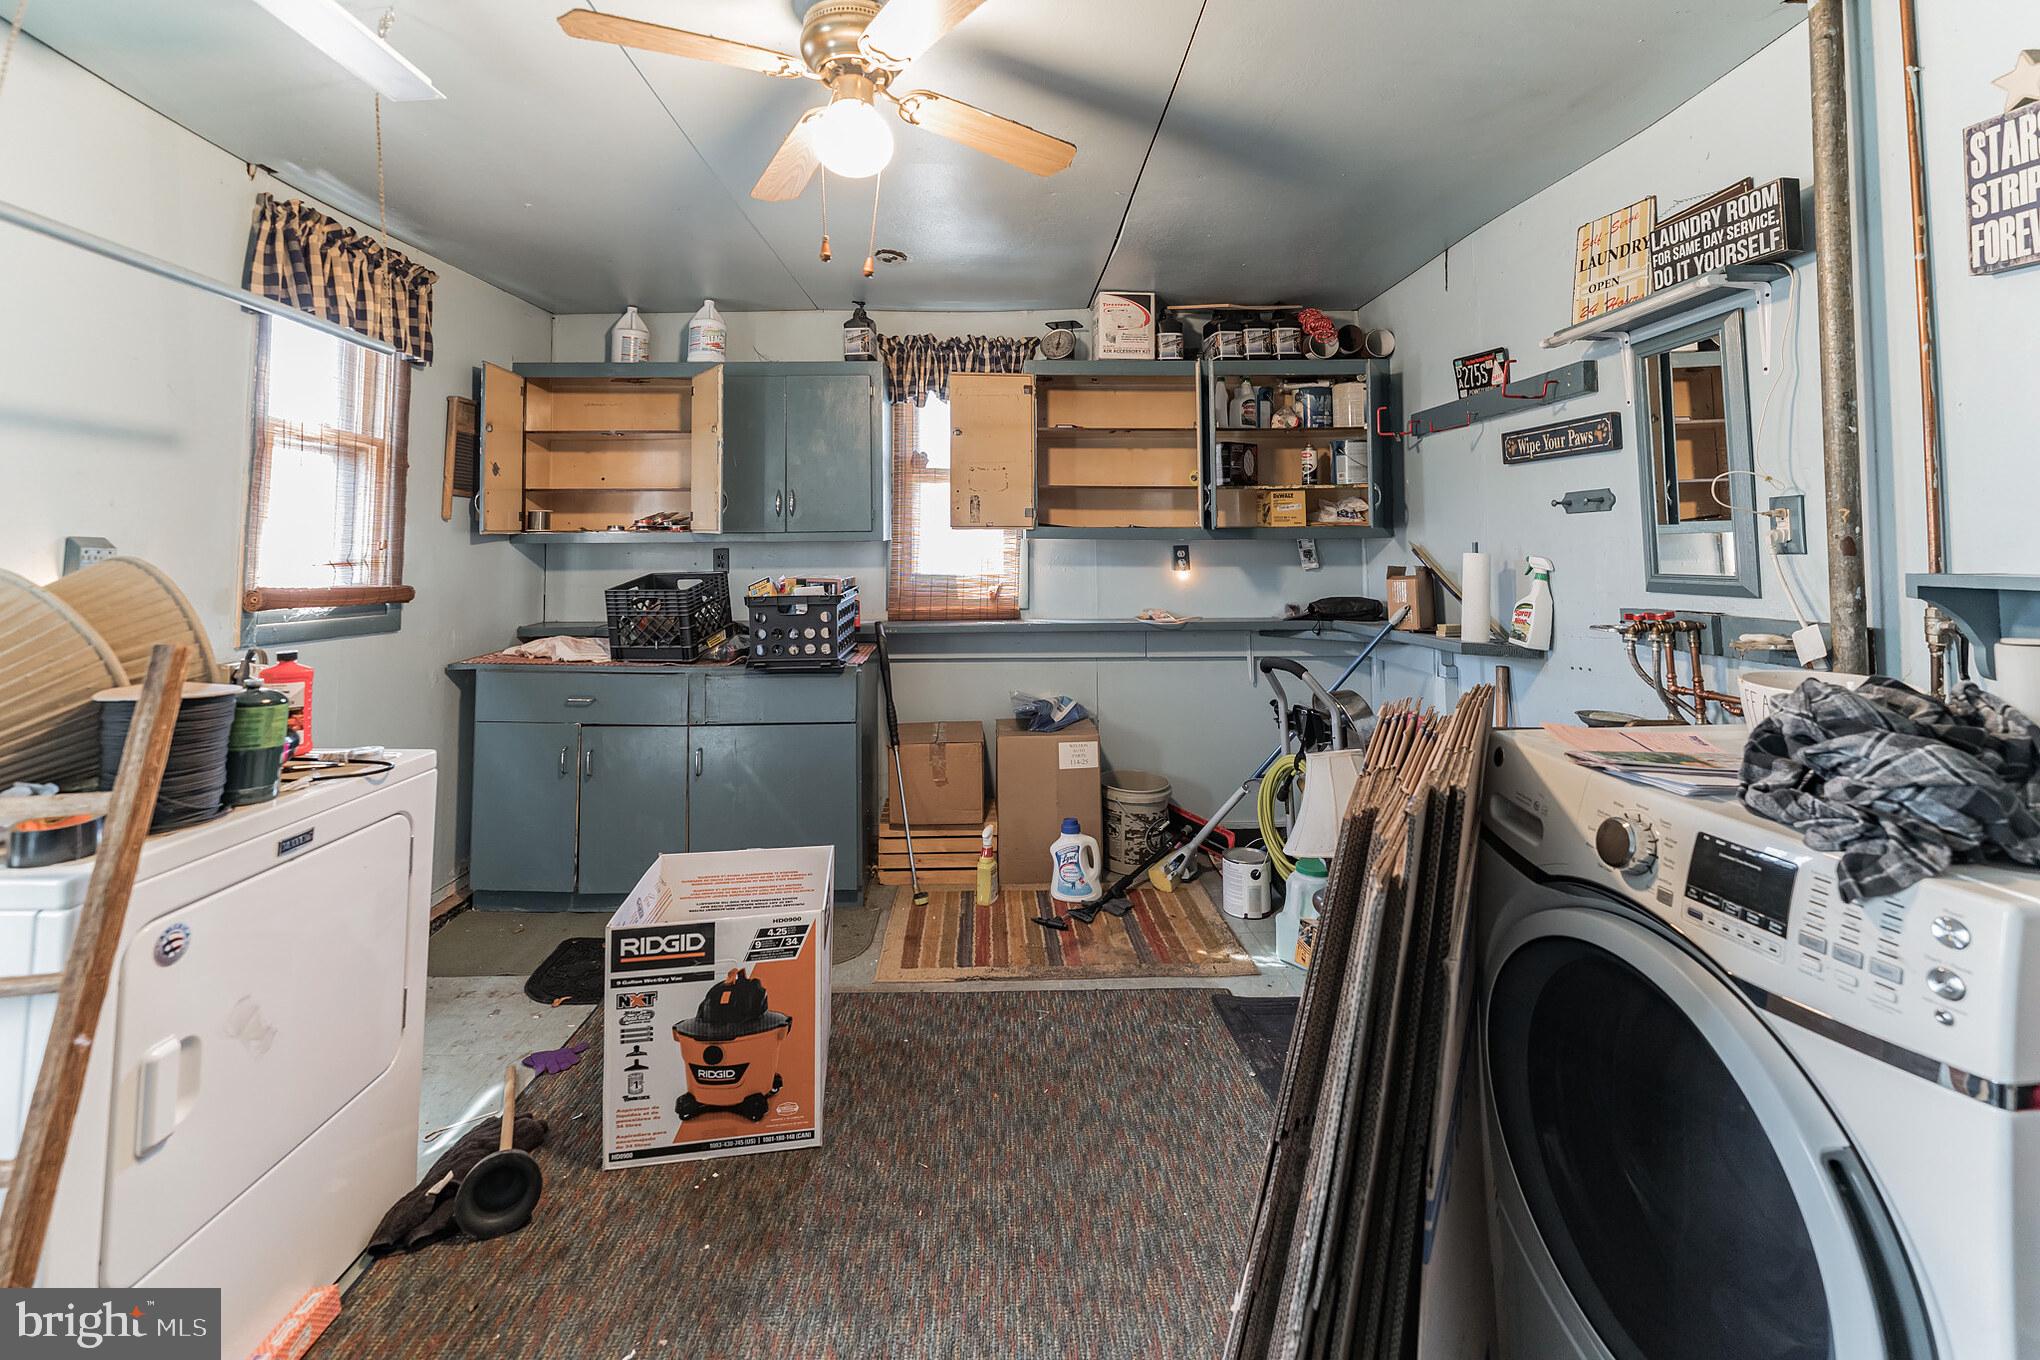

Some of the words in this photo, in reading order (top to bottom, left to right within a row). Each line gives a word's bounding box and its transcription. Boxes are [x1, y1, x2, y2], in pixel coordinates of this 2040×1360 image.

[1969, 109, 2040, 180] STAR
[1651, 206, 1721, 251] LAUNDRY
[1726, 183, 1778, 223] ROOM
[1652, 251, 1671, 268] FOR
[1672, 241, 1701, 261] SAME
[1703, 231, 1723, 251] DAY
[1727, 209, 1780, 240] SERVICE,
[1579, 236, 1650, 273] LAUNDRY
[1654, 267, 1673, 291] DO
[1674, 260, 1690, 283] IT
[1695, 227, 1781, 275] YOURSELF
[1588, 275, 1620, 294] OPEN
[1580, 302, 1599, 319] 24
[1517, 437, 1541, 458] Wipe
[1542, 433, 1565, 450] Your
[1567, 429, 1594, 446] Paws
[767, 927, 787, 936] 4.25
[620, 933, 706, 957] RIDGID
[618, 992, 656, 1008] NXT
[697, 1069, 736, 1079] RIDGID
